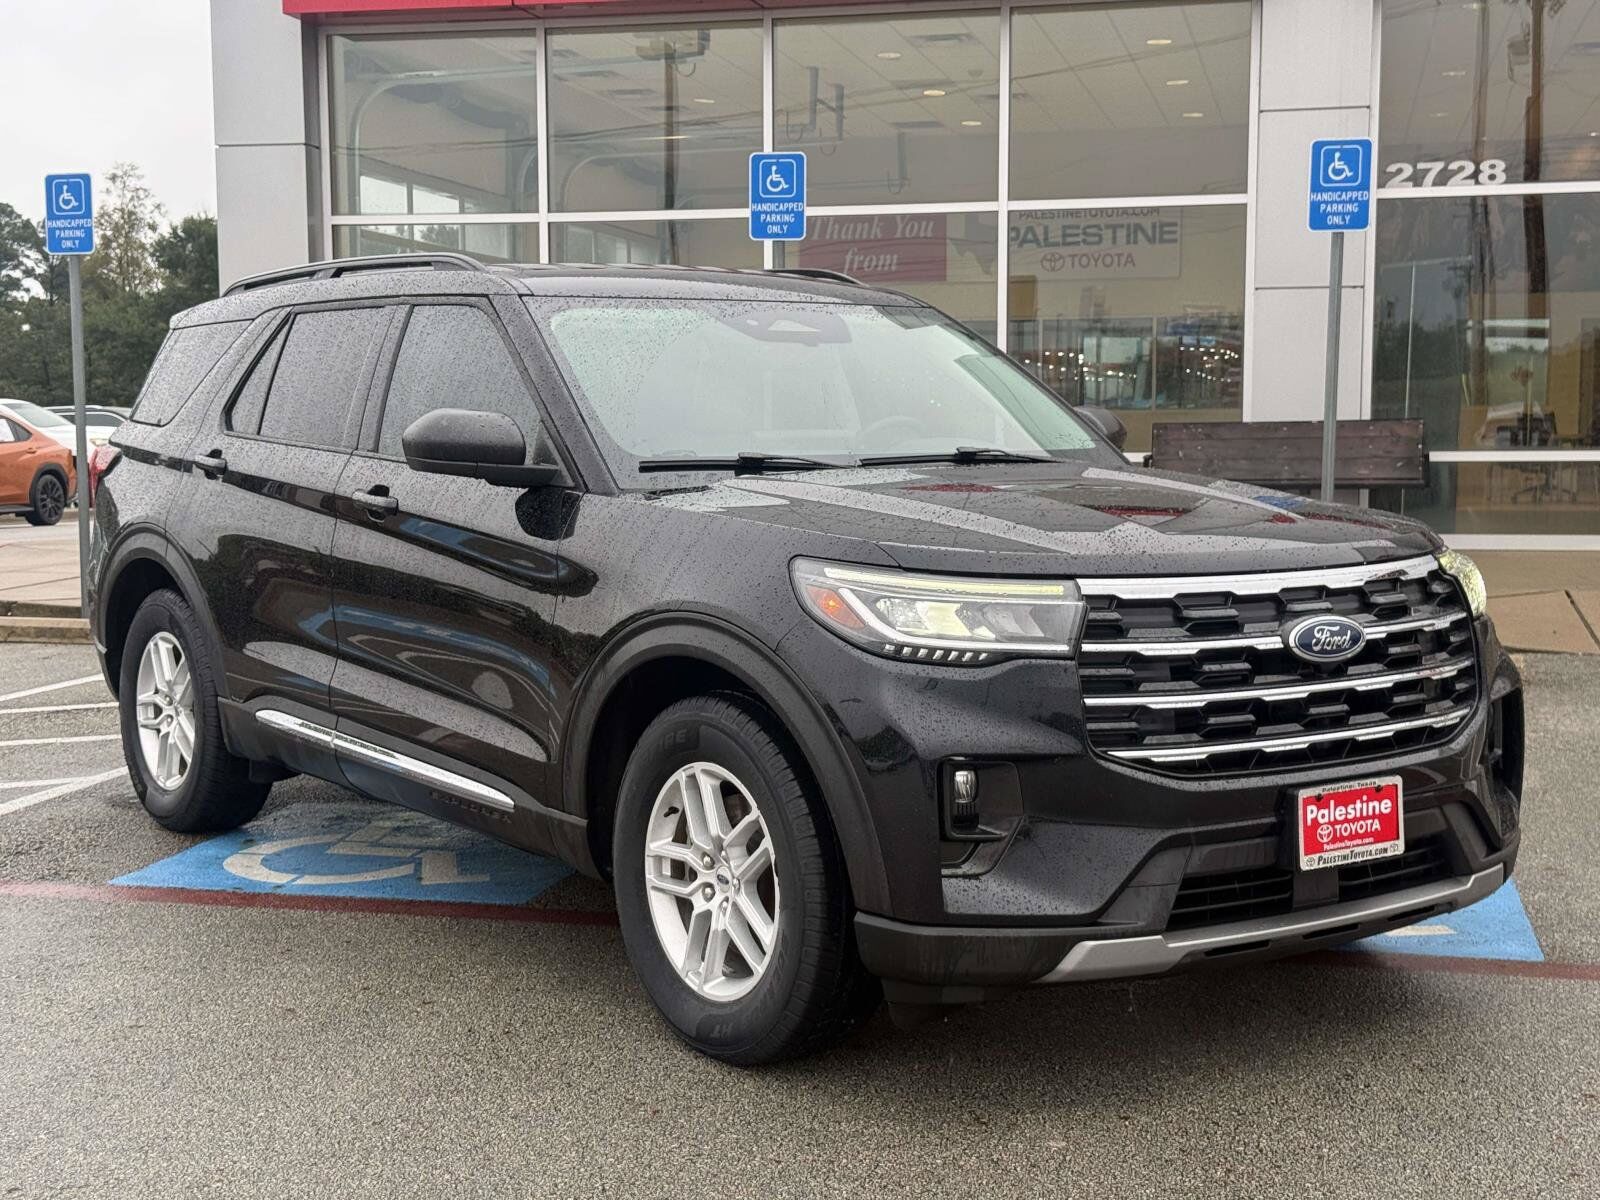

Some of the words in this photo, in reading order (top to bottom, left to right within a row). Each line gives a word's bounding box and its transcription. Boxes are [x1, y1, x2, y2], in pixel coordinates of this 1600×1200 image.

[1385, 159, 1506, 188] 2728
[1310, 191, 1369, 202] HANDICAPPED
[752, 202, 803, 211] HANDICAPPED
[1320, 203, 1359, 213] PARKING
[47, 219, 91, 228] HANDICAPPED
[761, 214, 794, 222] PARKING
[1327, 214, 1350, 225] ONLY
[767, 225, 788, 233] ONLY
[811, 215, 883, 240] Thank
[894, 214, 935, 238] You
[56, 229, 85, 238] PARKING
[1009, 221, 1179, 248] PALESTINE
[62, 240, 79, 248] ONLY
[843, 247, 899, 275] from
[1068, 252, 1136, 269] TOYOTA
[1311, 625, 1351, 652] Ford
[1306, 794, 1392, 827] Palestine
[1334, 818, 1381, 838] TOYOTA
